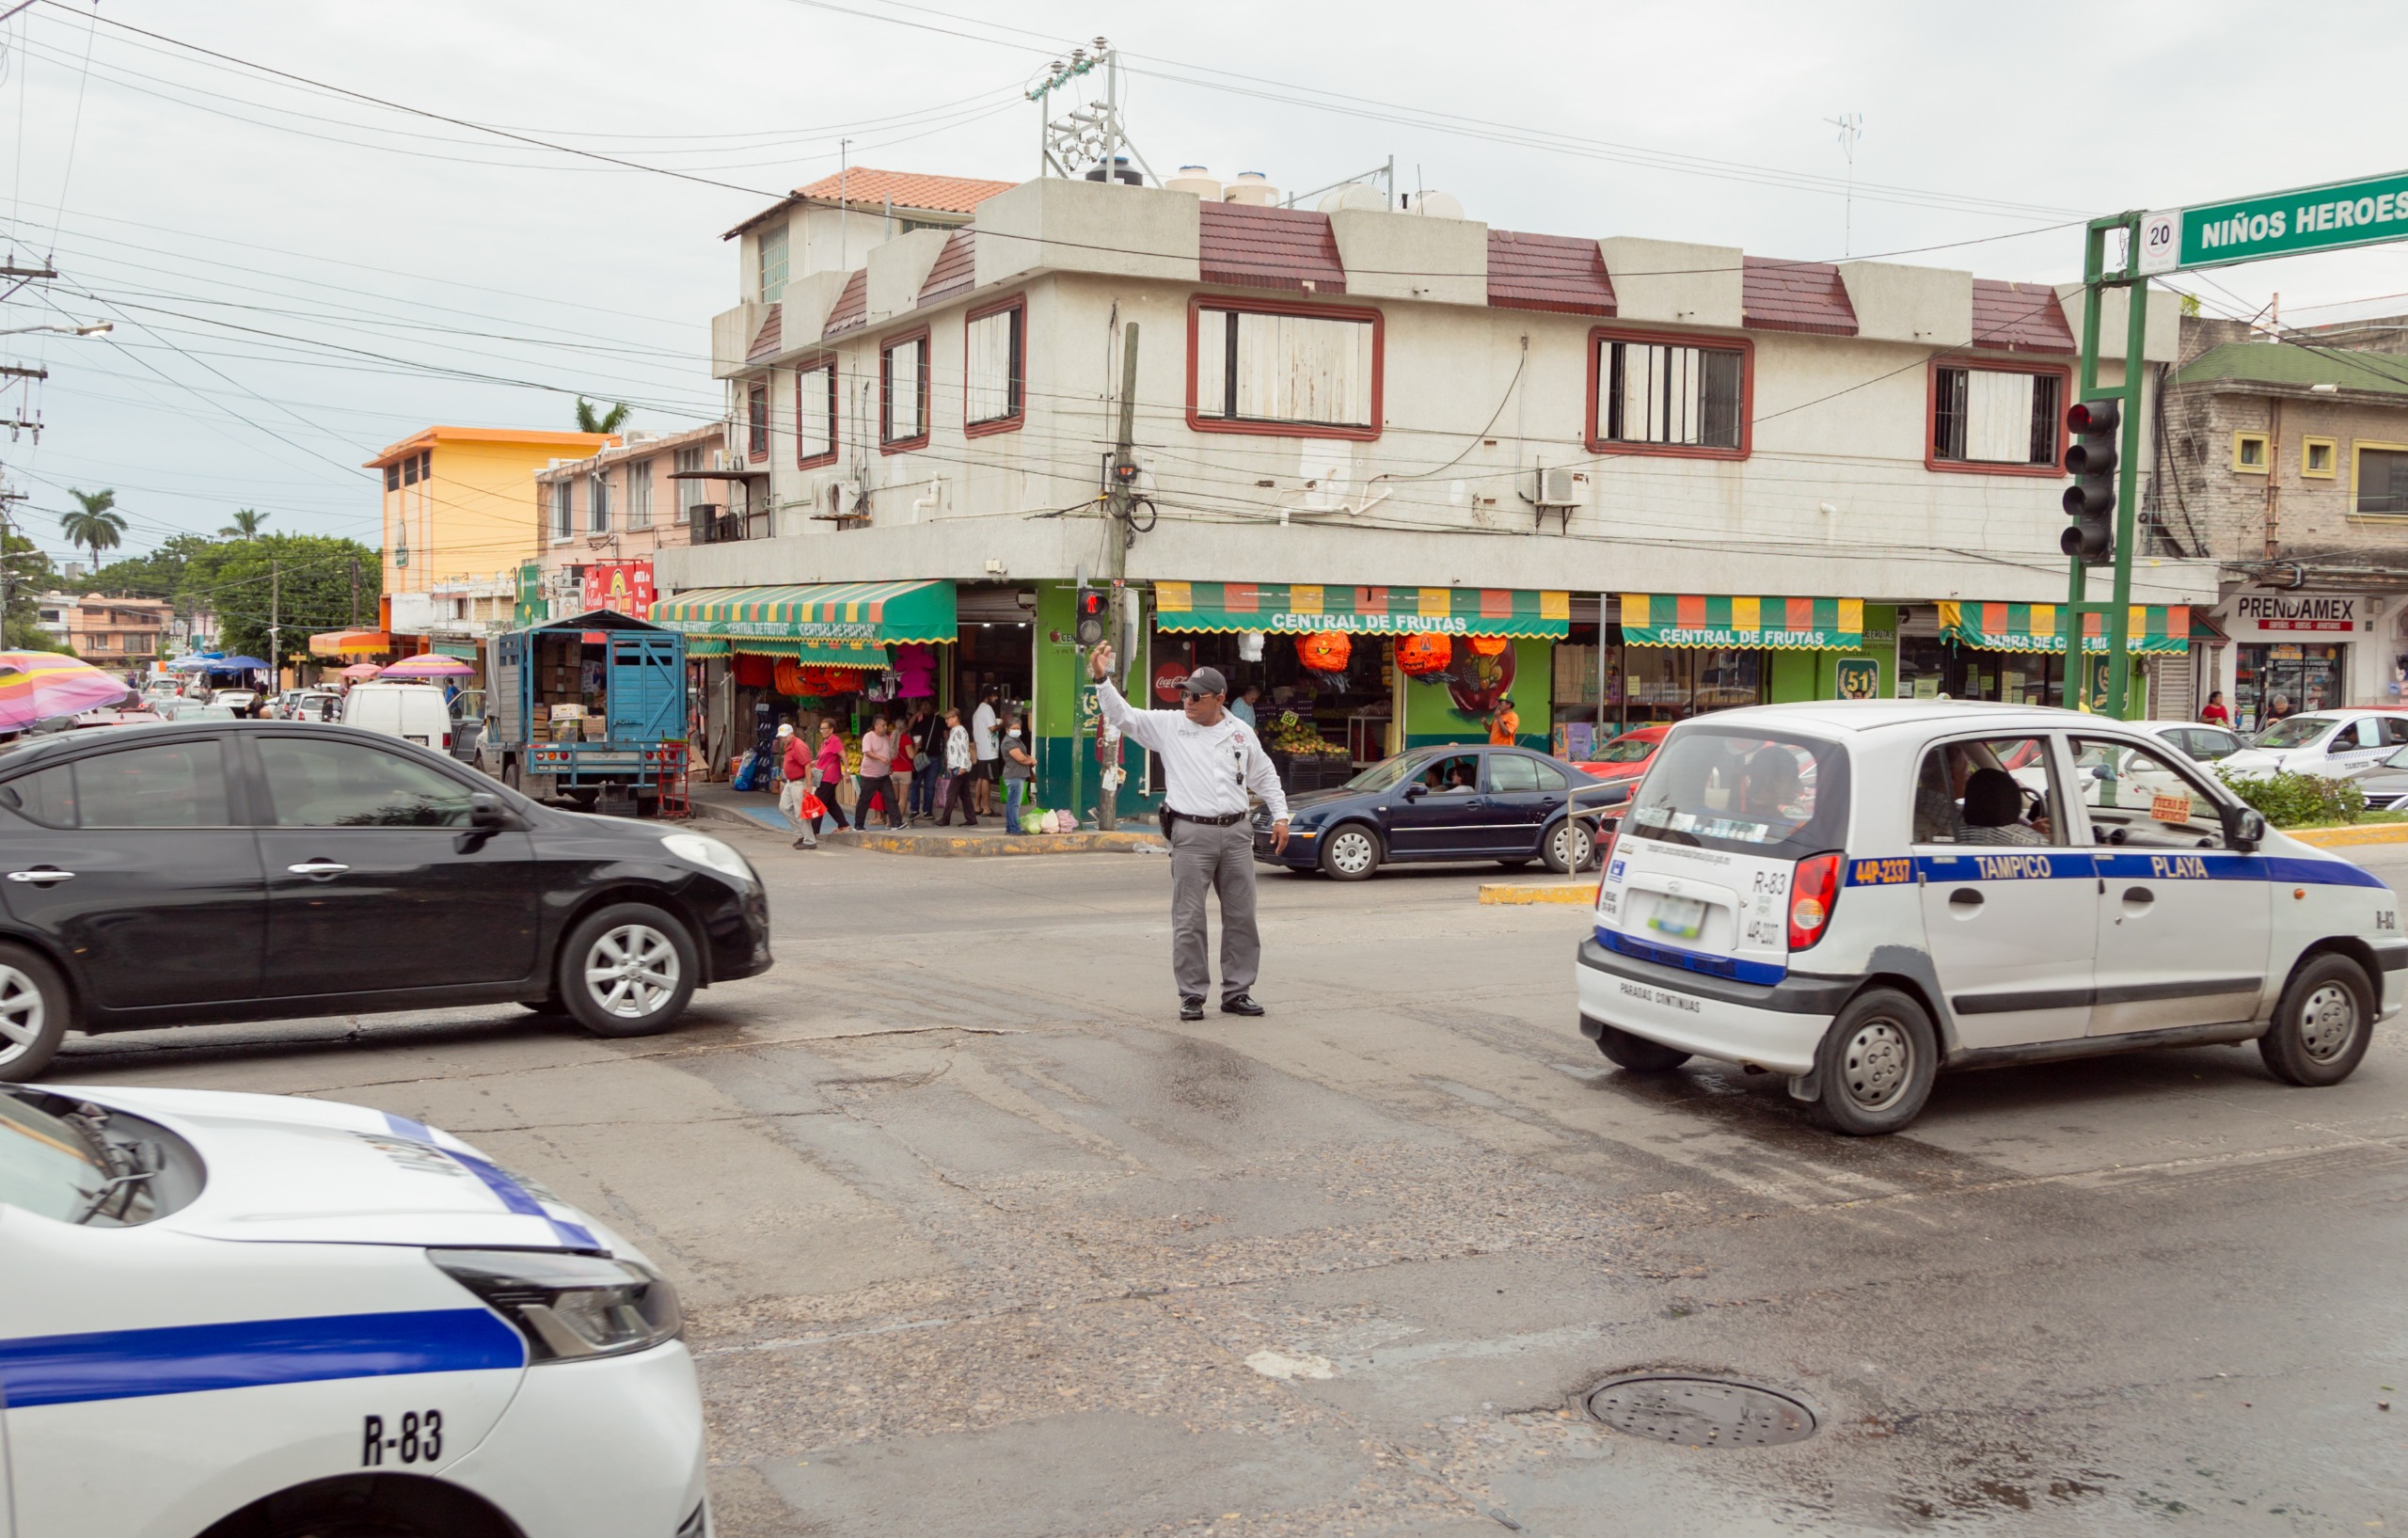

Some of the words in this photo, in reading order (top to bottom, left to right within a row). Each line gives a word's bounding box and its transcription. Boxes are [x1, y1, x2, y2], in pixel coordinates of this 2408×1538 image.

[2201, 212, 2287, 249] NIÑOS
[2295, 191, 2408, 234] HEROES
[2150, 225, 2170, 246] 20
[2238, 596, 2354, 620] PRENDAMEX
[755, 623, 763, 635] DE
[1272, 613, 1361, 629] CENTRAL
[1367, 614, 1390, 629] DE
[1396, 615, 1467, 631] FRUTAS
[1660, 628, 1735, 643] CENTRAL
[1740, 629, 1760, 644] DE
[1765, 630, 1825, 644] FRUTAS
[1984, 634, 2029, 648] BARRA
[2033, 636, 2052, 649] DE
[2054, 637, 2088, 649] CE
[2092, 637, 2107, 649] MI
[1846, 671, 1869, 692] 51
[1089, 694, 1099, 710] 5
[1855, 859, 1911, 884] 44P-2337
[1974, 855, 2052, 880] TAMPICO
[2150, 856, 2210, 879] PLAYA
[1752, 870, 1787, 896] R-83
[1620, 982, 1654, 1003] PARADAS
[1656, 991, 1701, 1013] CONTINUAS
[361, 1408, 442, 1467] R-83
